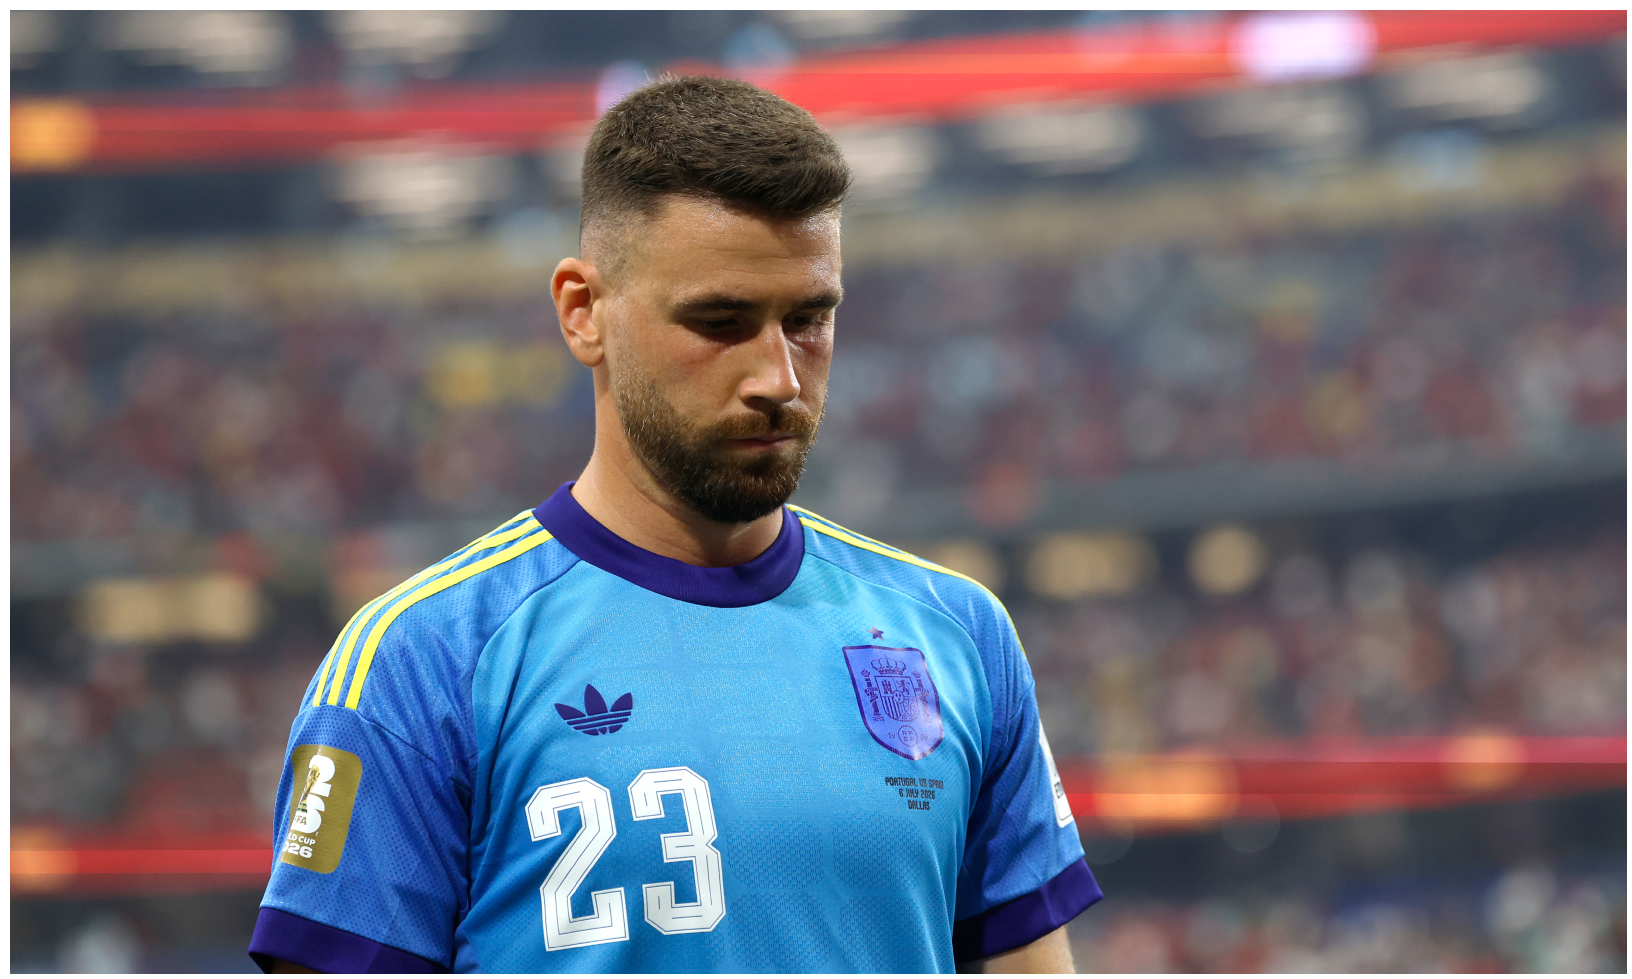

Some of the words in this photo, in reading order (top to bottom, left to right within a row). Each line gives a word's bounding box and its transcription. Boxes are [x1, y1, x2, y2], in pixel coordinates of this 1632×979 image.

[885, 777, 918, 788] PORTUGAL
[929, 779, 944, 790] SPAIN
[899, 788, 904, 798] 6
[906, 788, 919, 799] JULY
[921, 789, 936, 800] 2026
[908, 800, 930, 811] DALLAS
[298, 835, 316, 846] CUP
[524, 766, 727, 952] 23
